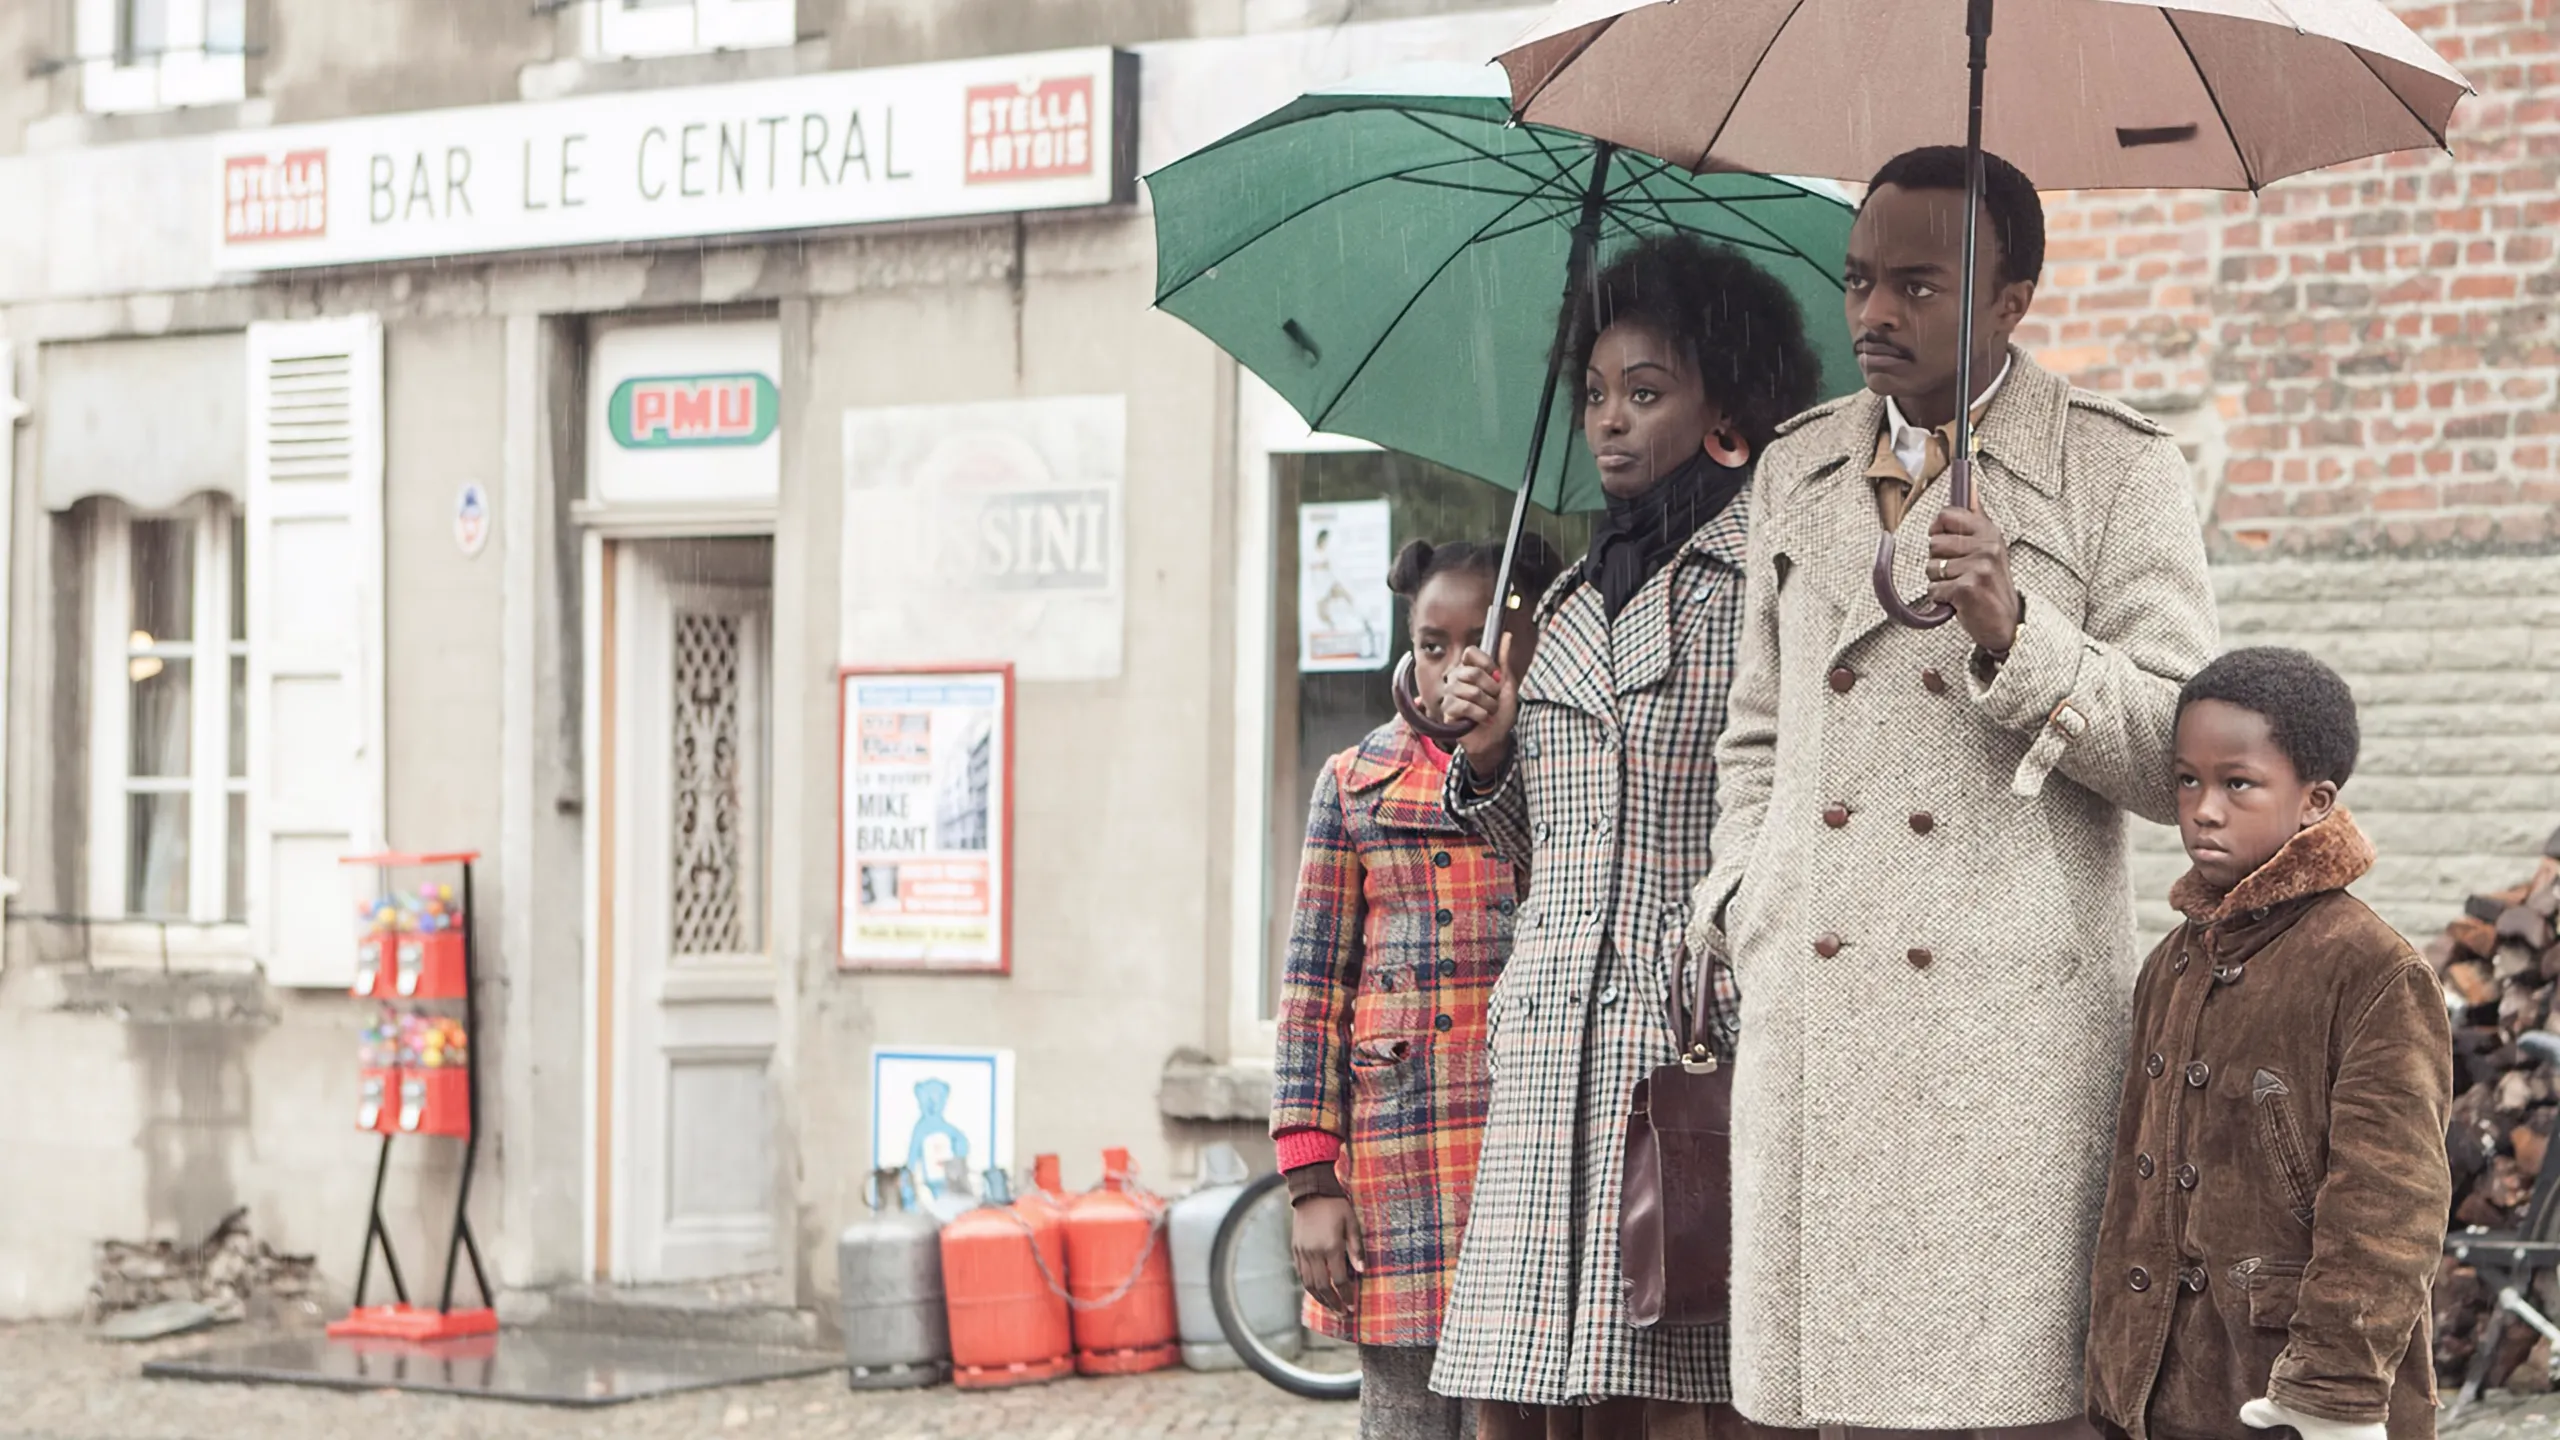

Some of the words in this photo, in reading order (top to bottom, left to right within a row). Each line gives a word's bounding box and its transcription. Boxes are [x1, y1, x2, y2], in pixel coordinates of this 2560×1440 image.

[969, 89, 1087, 135] STELLA
[370, 146, 473, 225] BAR
[523, 134, 587, 211] LE
[637, 106, 912, 201] CENTRAL
[969, 129, 1088, 174] ANTOIS
[634, 380, 754, 438] PMU
[857, 793, 909, 819] MIKE
[857, 825, 928, 853] BRANT
